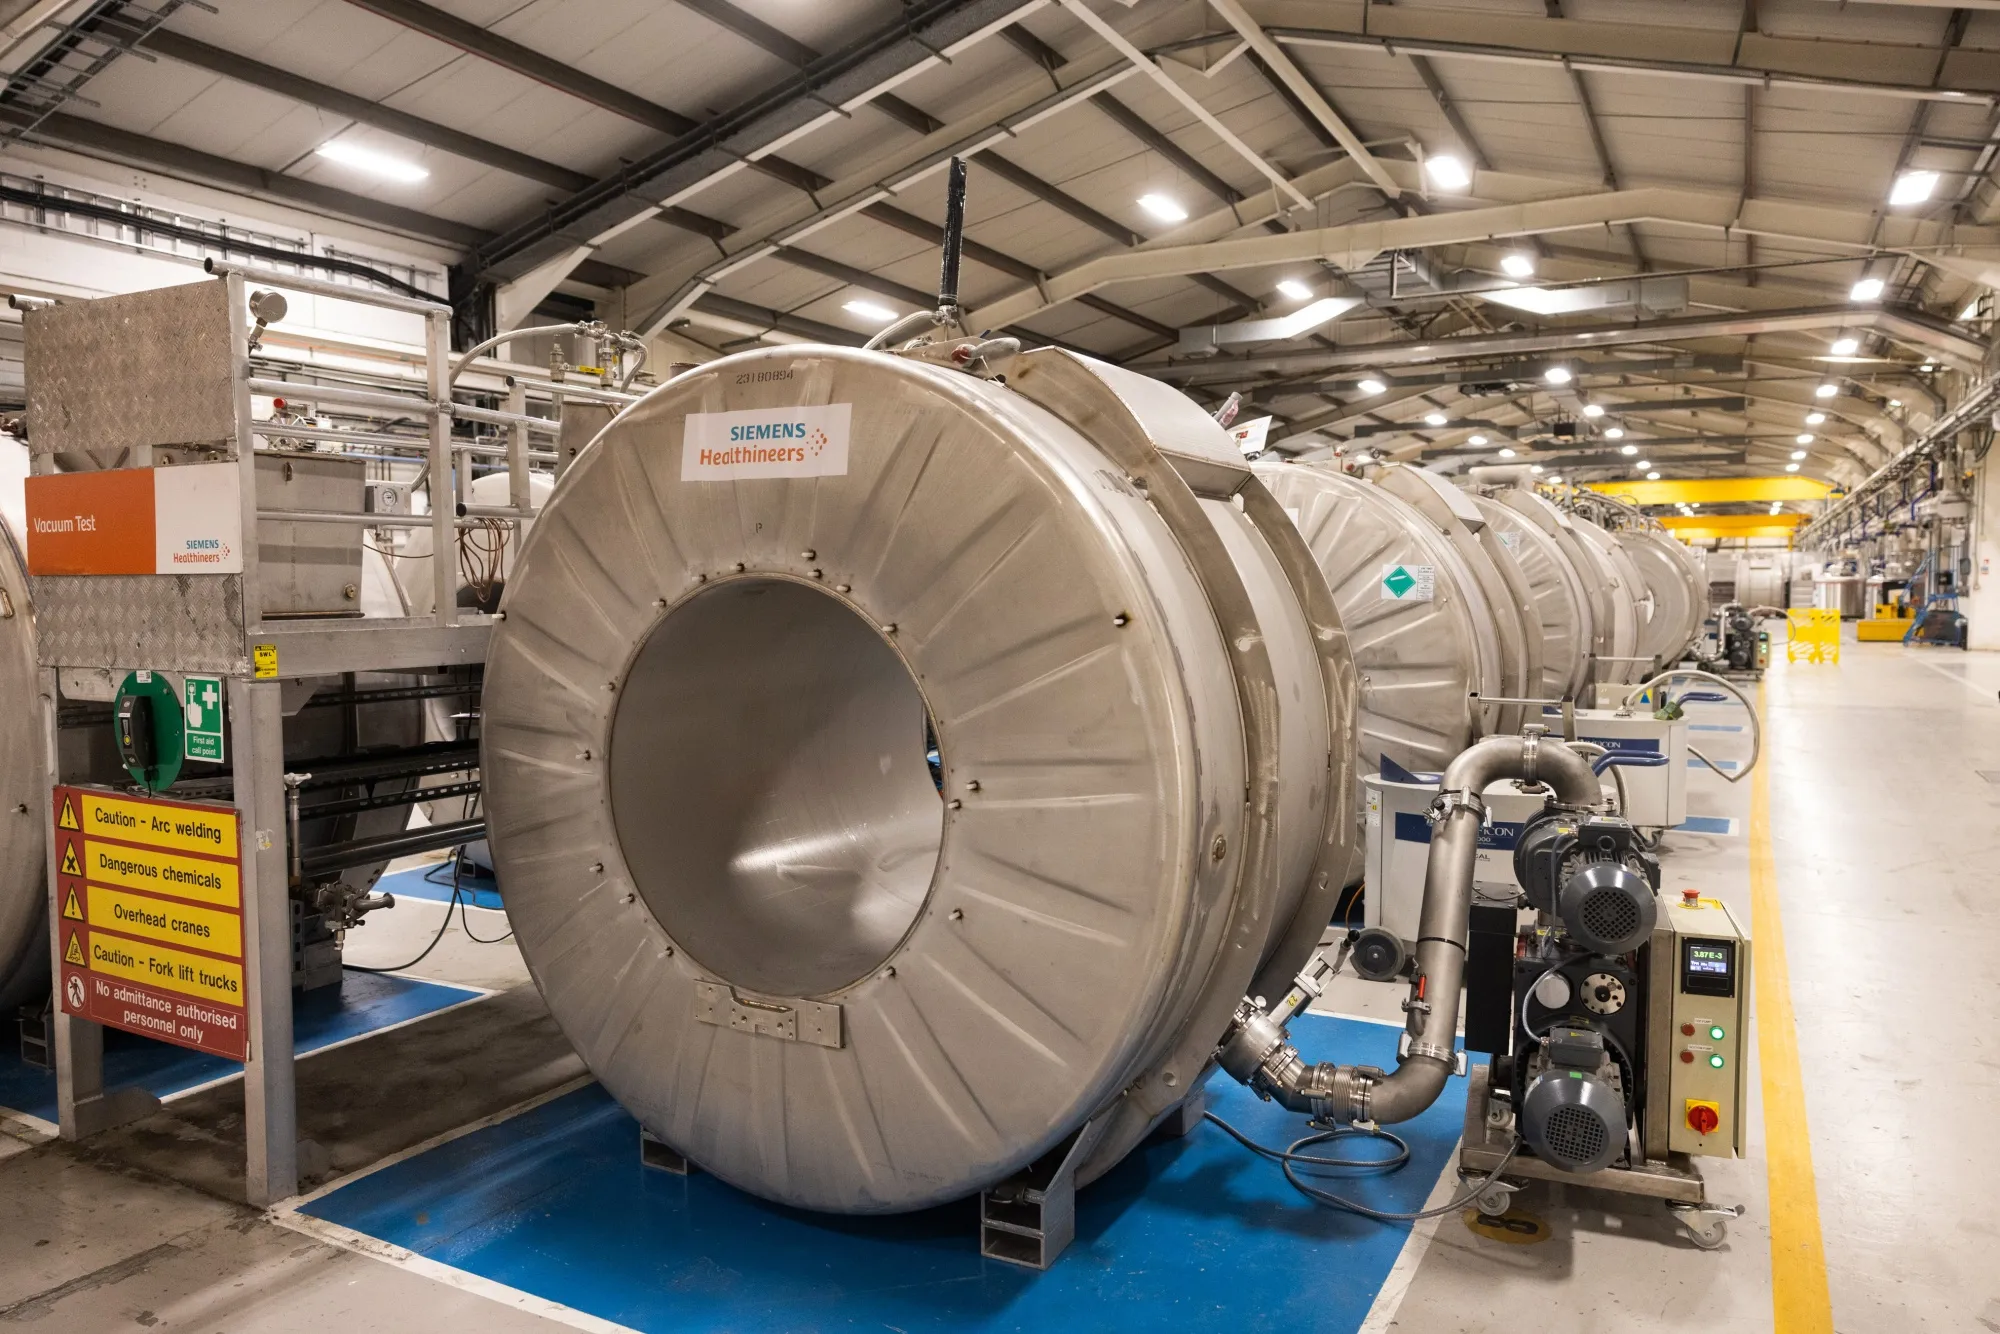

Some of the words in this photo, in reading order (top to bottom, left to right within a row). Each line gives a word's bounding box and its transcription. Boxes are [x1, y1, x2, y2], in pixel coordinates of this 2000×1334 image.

[730, 422, 806, 441] SIEMENS
[700, 444, 805, 466] Healthineers
[34, 516, 74, 533] Vacuum
[75, 514, 96, 532] Test
[186, 539, 219, 550] SIEMENS
[173, 550, 220, 563] Healthineers
[193, 735, 205, 744] First
[206, 737, 214, 745] aid
[192, 746, 201, 754] call
[202, 747, 216, 756] point
[95, 807, 136, 828] Caution
[151, 816, 171, 833] Arc
[176, 822, 222, 843] welding
[1479, 827, 1514, 837] ICON
[100, 853, 158, 878] Dangerous
[162, 866, 222, 889] chemicals
[114, 904, 166, 928] Overhead
[171, 918, 210, 937] cranes
[94, 945, 134, 968] Caution
[149, 958, 173, 977] Fork
[179, 964, 194, 982] lift
[199, 969, 238, 992] trucks
[96, 980, 110, 997] No
[113, 984, 171, 1013] admittance
[176, 998, 237, 1030] authorised
[123, 1010, 176, 1034] personnel
[180, 1024, 203, 1044] only
